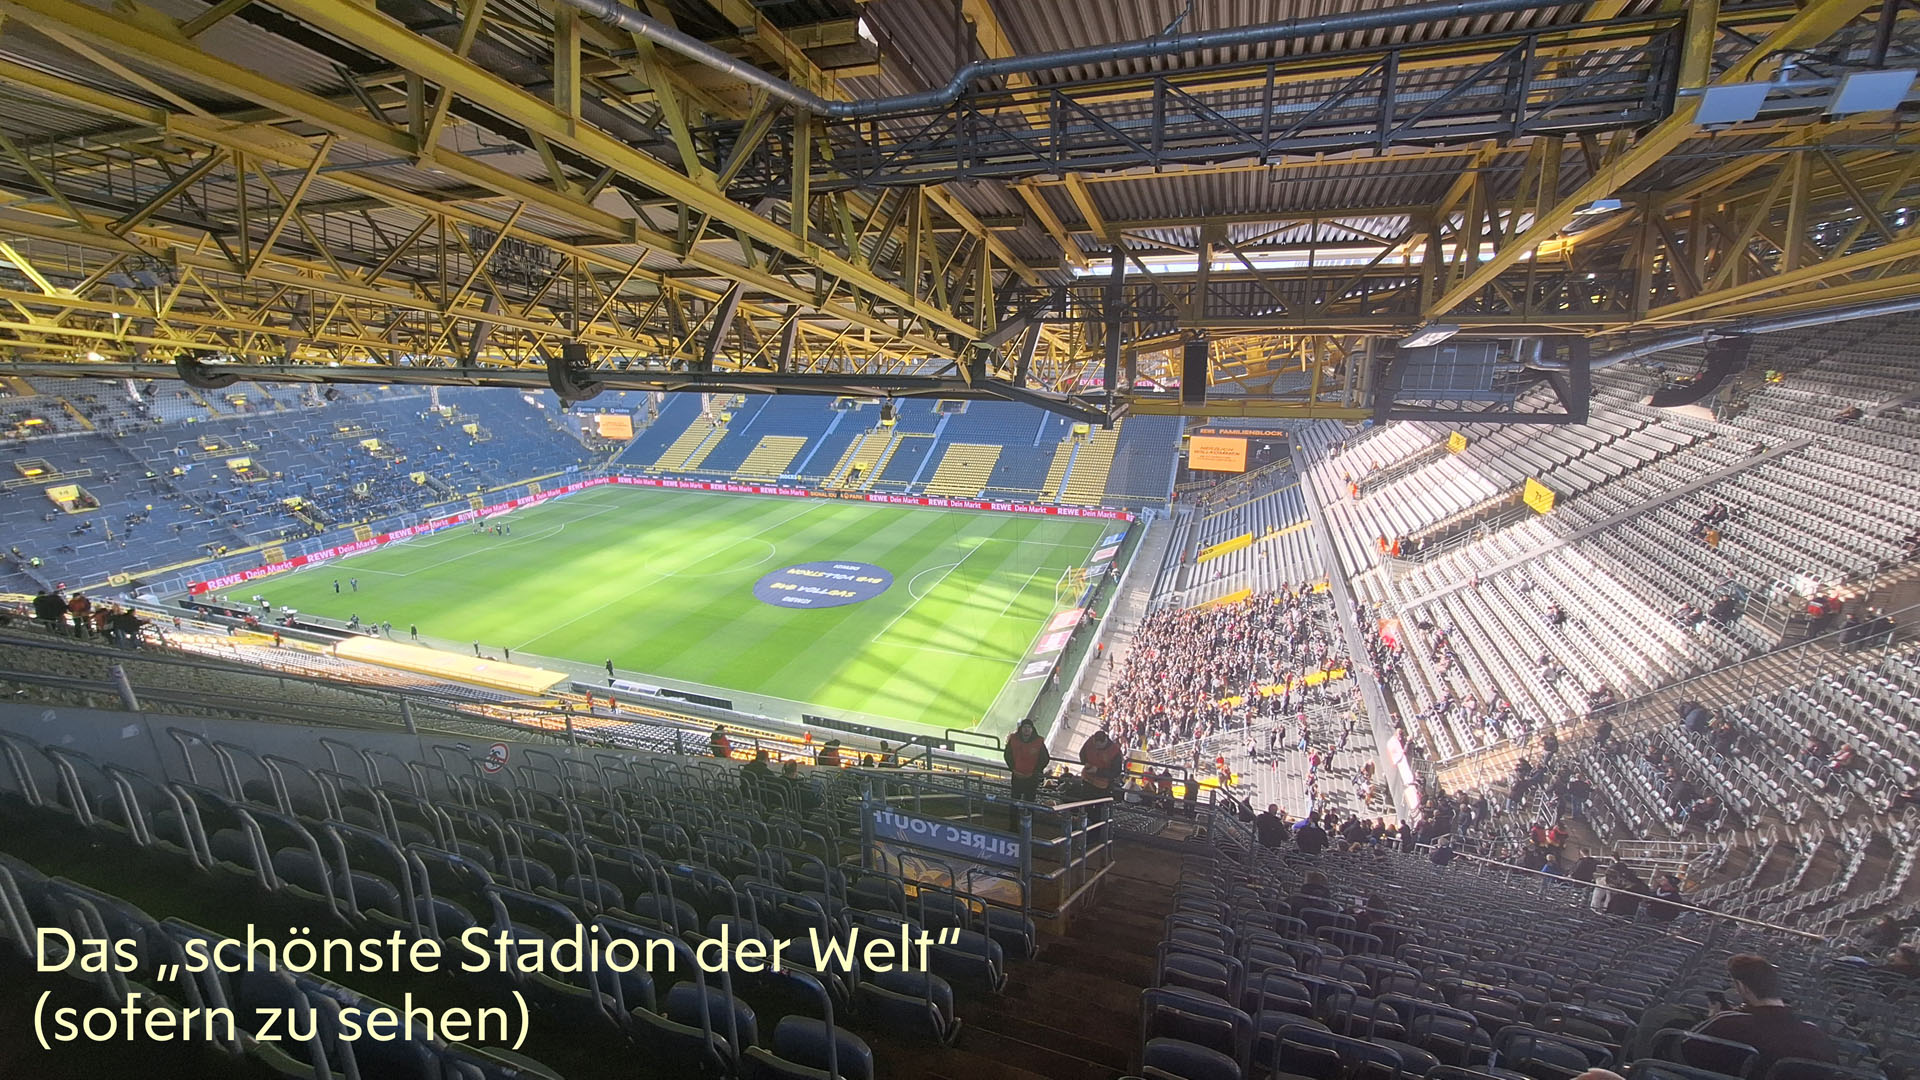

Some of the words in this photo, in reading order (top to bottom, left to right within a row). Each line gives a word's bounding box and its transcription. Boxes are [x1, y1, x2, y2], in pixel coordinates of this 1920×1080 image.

[1219, 428, 1283, 437] FAMILIENBLOCK
[517, 496, 534, 505] REWE
[928, 498, 948, 506] REWE
[950, 500, 963, 508] Dein
[991, 503, 1012, 511] REWE
[1057, 508, 1079, 516] REWE
[388, 528, 412, 541] REWE
[415, 524, 431, 533] Dein
[307, 549, 335, 563] REWE
[337, 545, 354, 555] Dein
[355, 538, 378, 550] Markt
[207, 574, 242, 590] REWE
[246, 567, 266, 579] Dein
[267, 561, 293, 575] Markt
[797, 586, 856, 598] VOLLGAS
